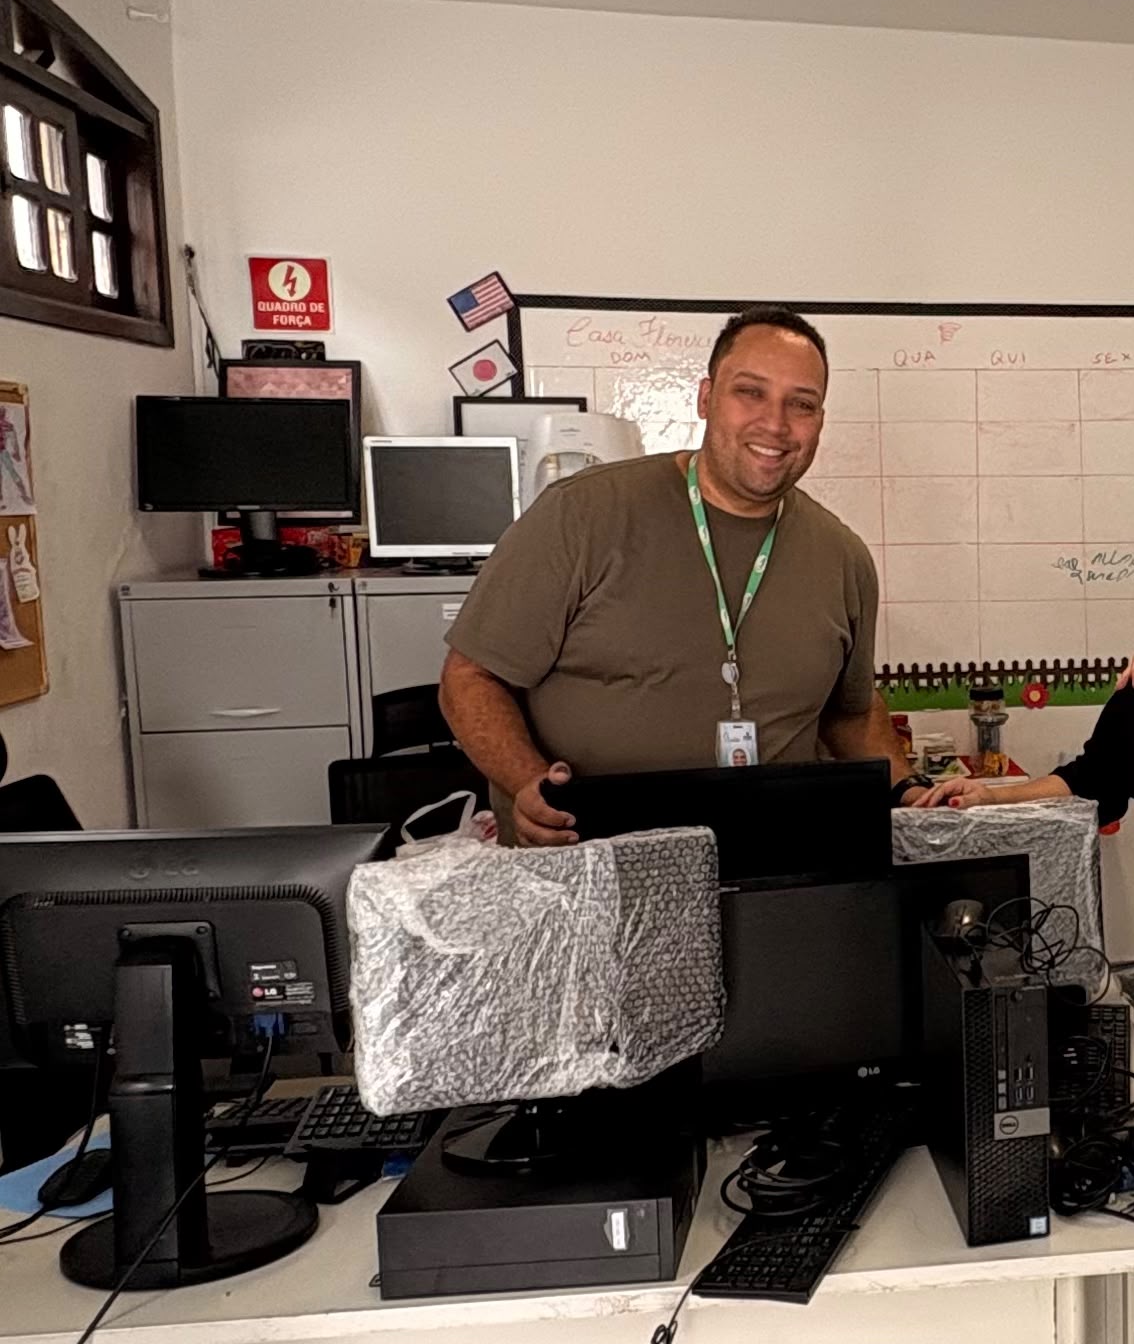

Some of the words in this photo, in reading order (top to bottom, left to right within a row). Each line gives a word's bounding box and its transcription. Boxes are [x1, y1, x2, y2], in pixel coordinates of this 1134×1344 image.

[257, 301, 307, 313] QUADRO
[309, 302, 326, 313] DE
[272, 314, 312, 327] FORÇA
[566, 315, 626, 348] Casa
[610, 351, 651, 364] DOM
[893, 349, 936, 367] QUA
[990, 349, 1026, 366] QUI
